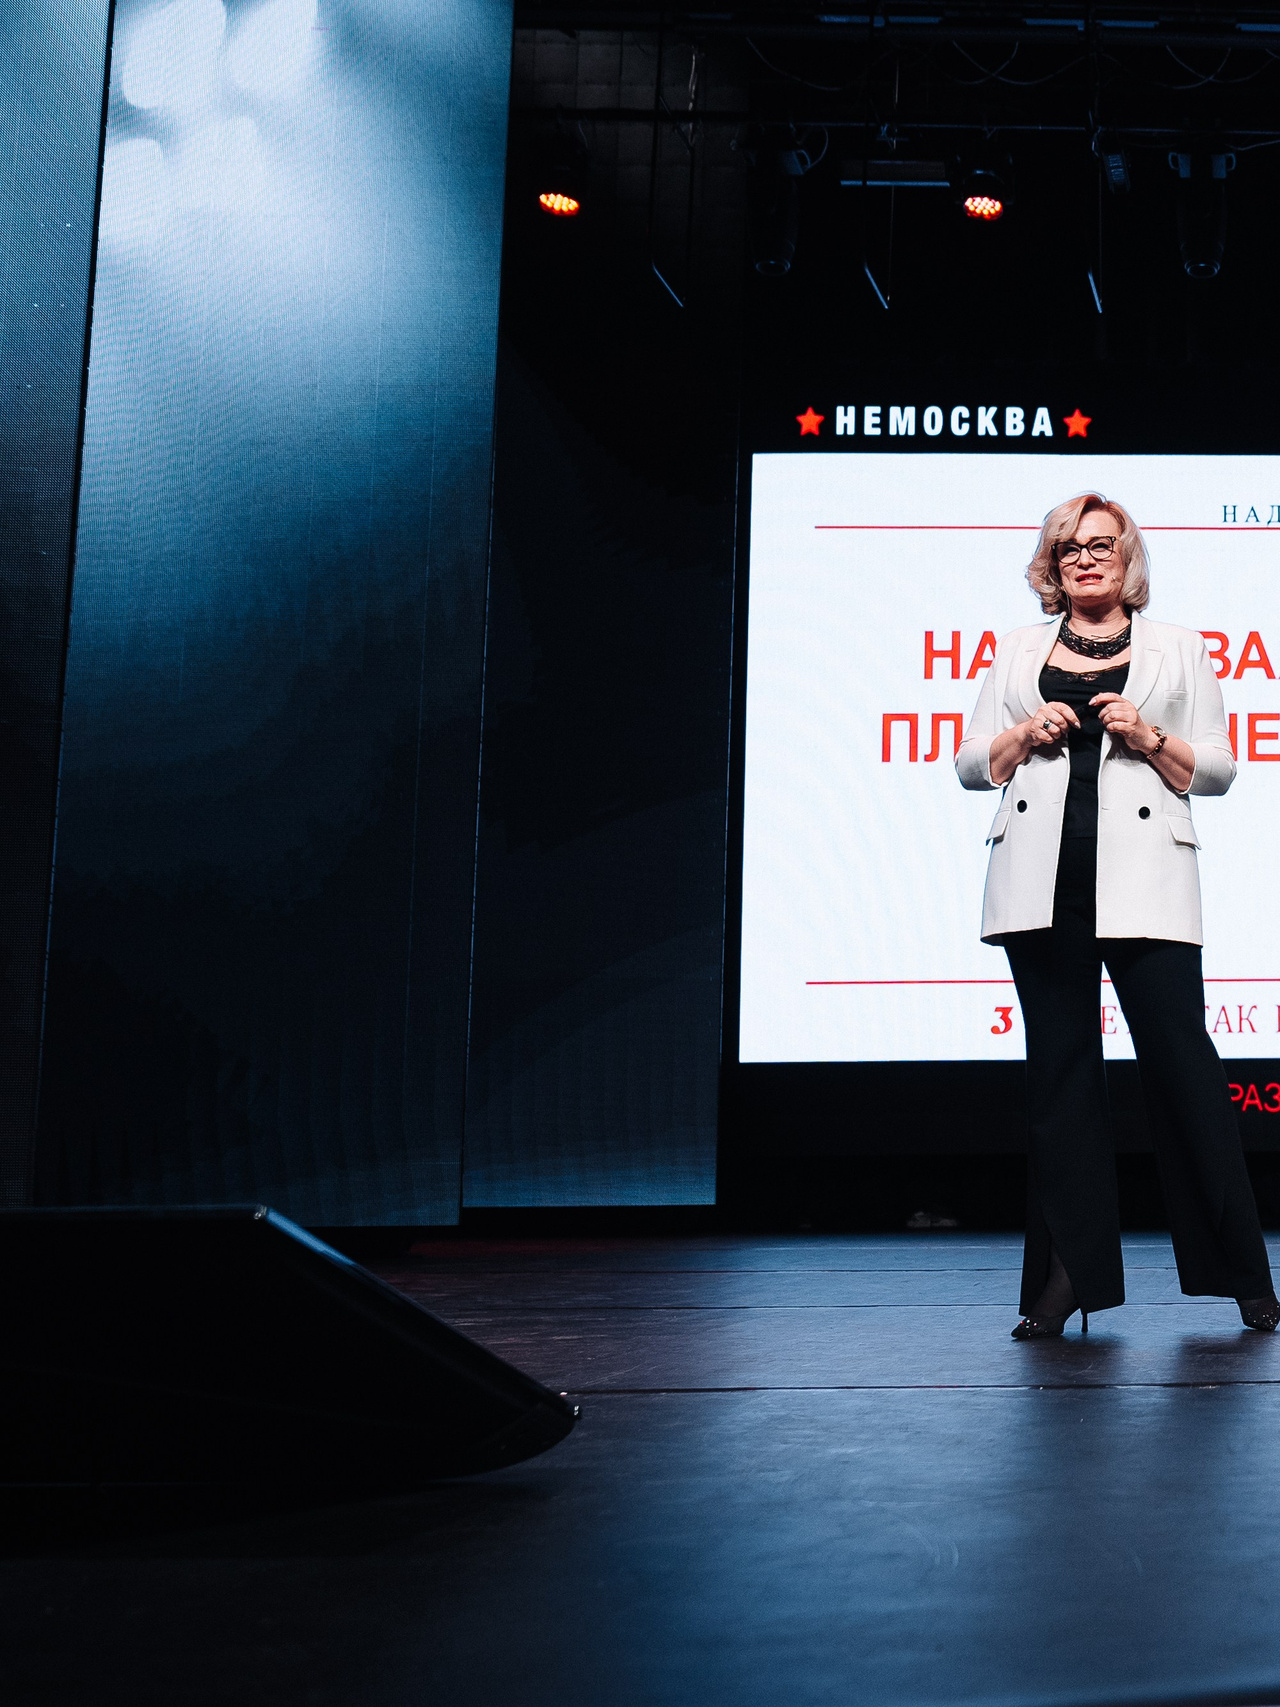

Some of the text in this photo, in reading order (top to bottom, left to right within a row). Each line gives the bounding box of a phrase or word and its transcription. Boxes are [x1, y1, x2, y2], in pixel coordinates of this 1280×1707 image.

[834, 405, 1054, 437] НЕМОСКВА
[990, 1006, 1014, 1035] 3
[1204, 1004, 1258, 1034] АК
